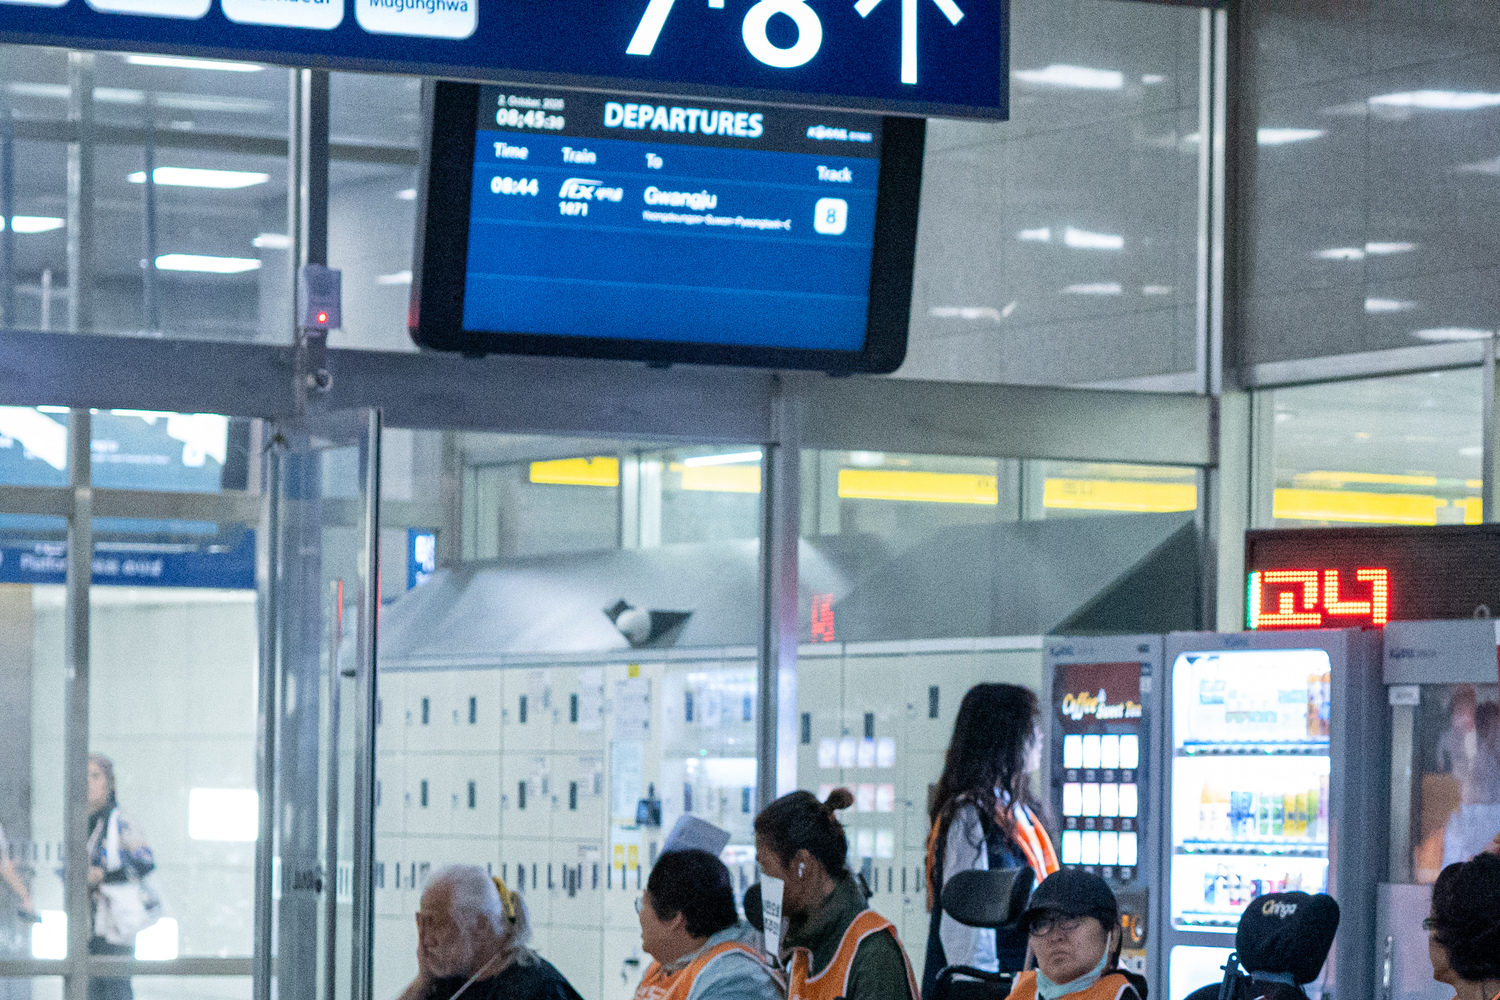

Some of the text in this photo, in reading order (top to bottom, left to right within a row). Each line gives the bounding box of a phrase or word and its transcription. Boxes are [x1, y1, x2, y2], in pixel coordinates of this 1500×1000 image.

[604, 102, 764, 138] DEPARTURES
[494, 142, 853, 184] Time Train To Track
[491, 177, 539, 197] 08:44
[643, 186, 718, 211] Gwangju
[826, 207, 836, 225] 8
